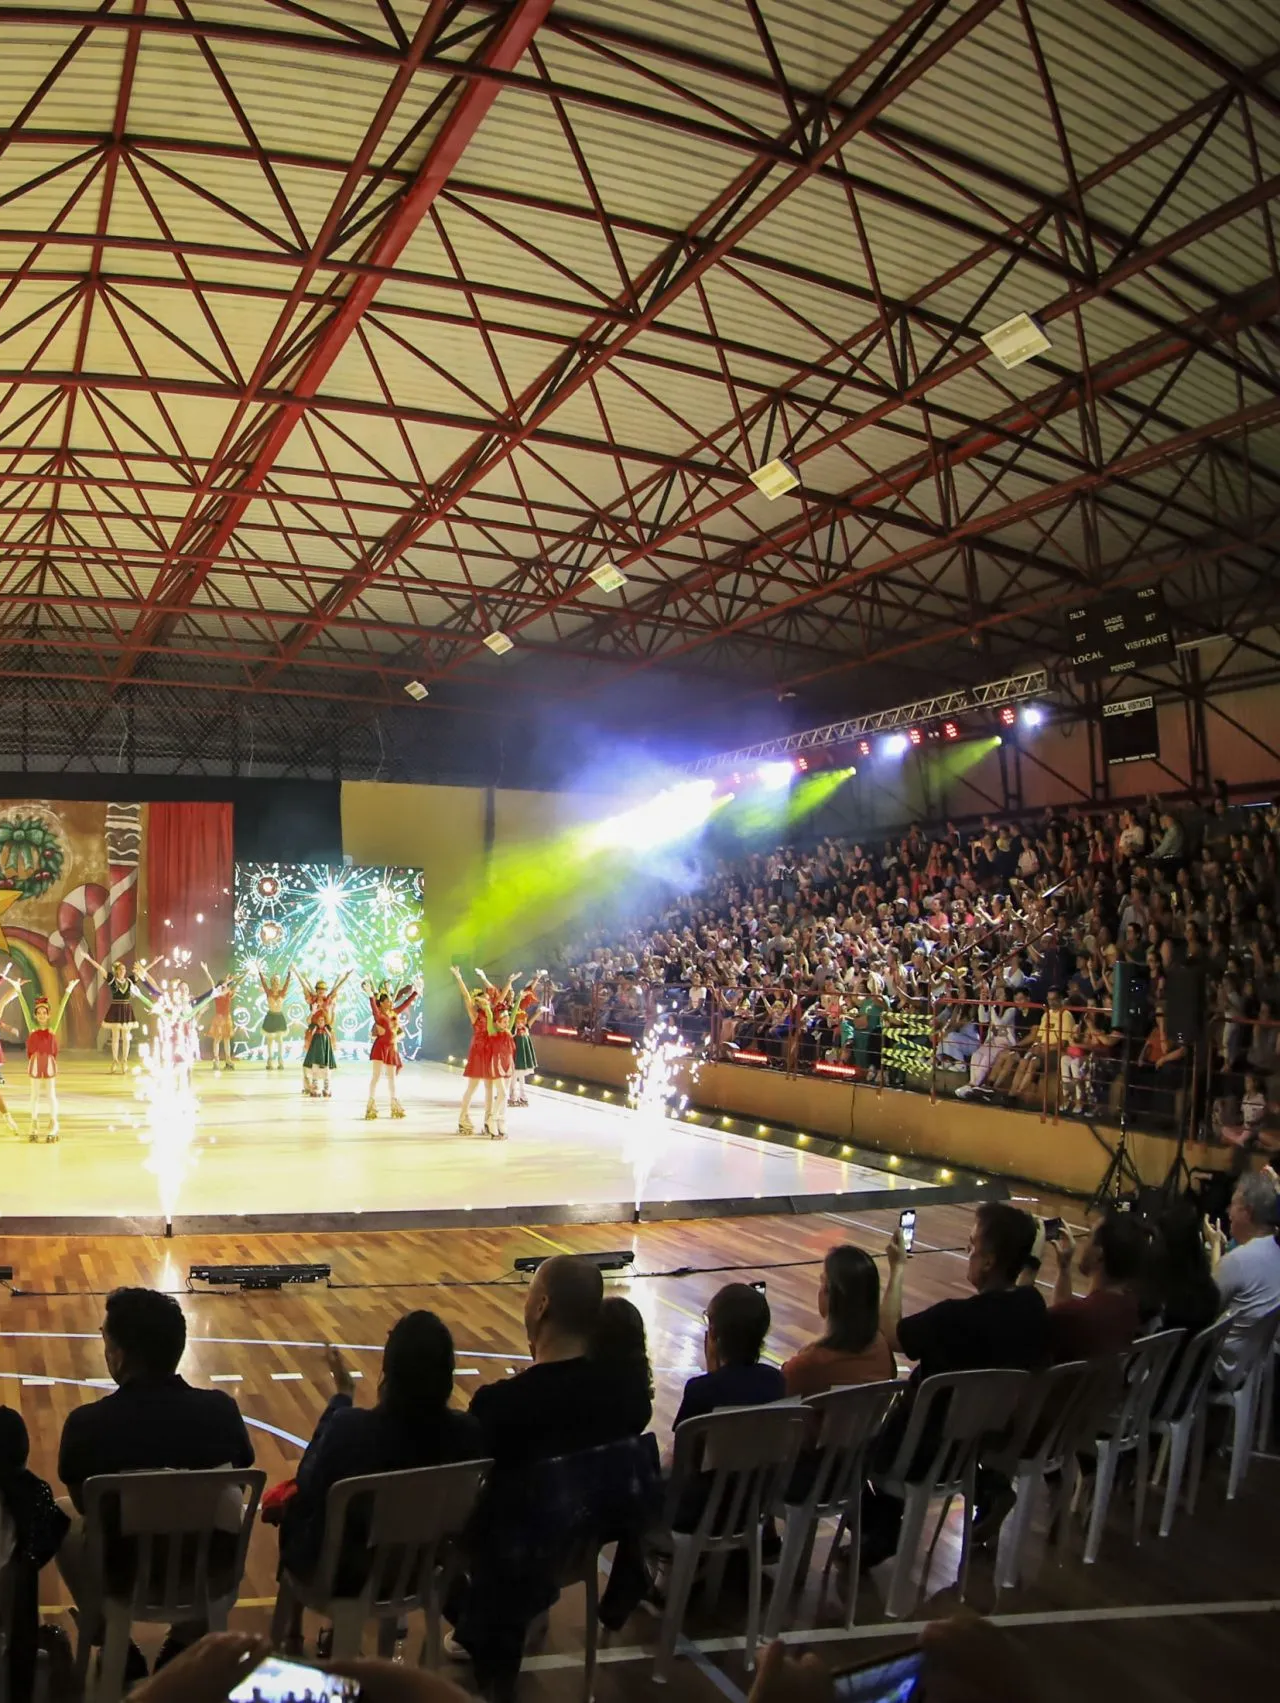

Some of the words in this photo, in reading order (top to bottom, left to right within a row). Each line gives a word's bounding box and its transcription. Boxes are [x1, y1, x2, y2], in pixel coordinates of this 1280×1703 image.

[1124, 633, 1169, 650] VISITANTE
[1072, 650, 1104, 665] LOCAL
[1103, 704, 1126, 714] LOCAL
[1127, 699, 1151, 709] VISITANTE
